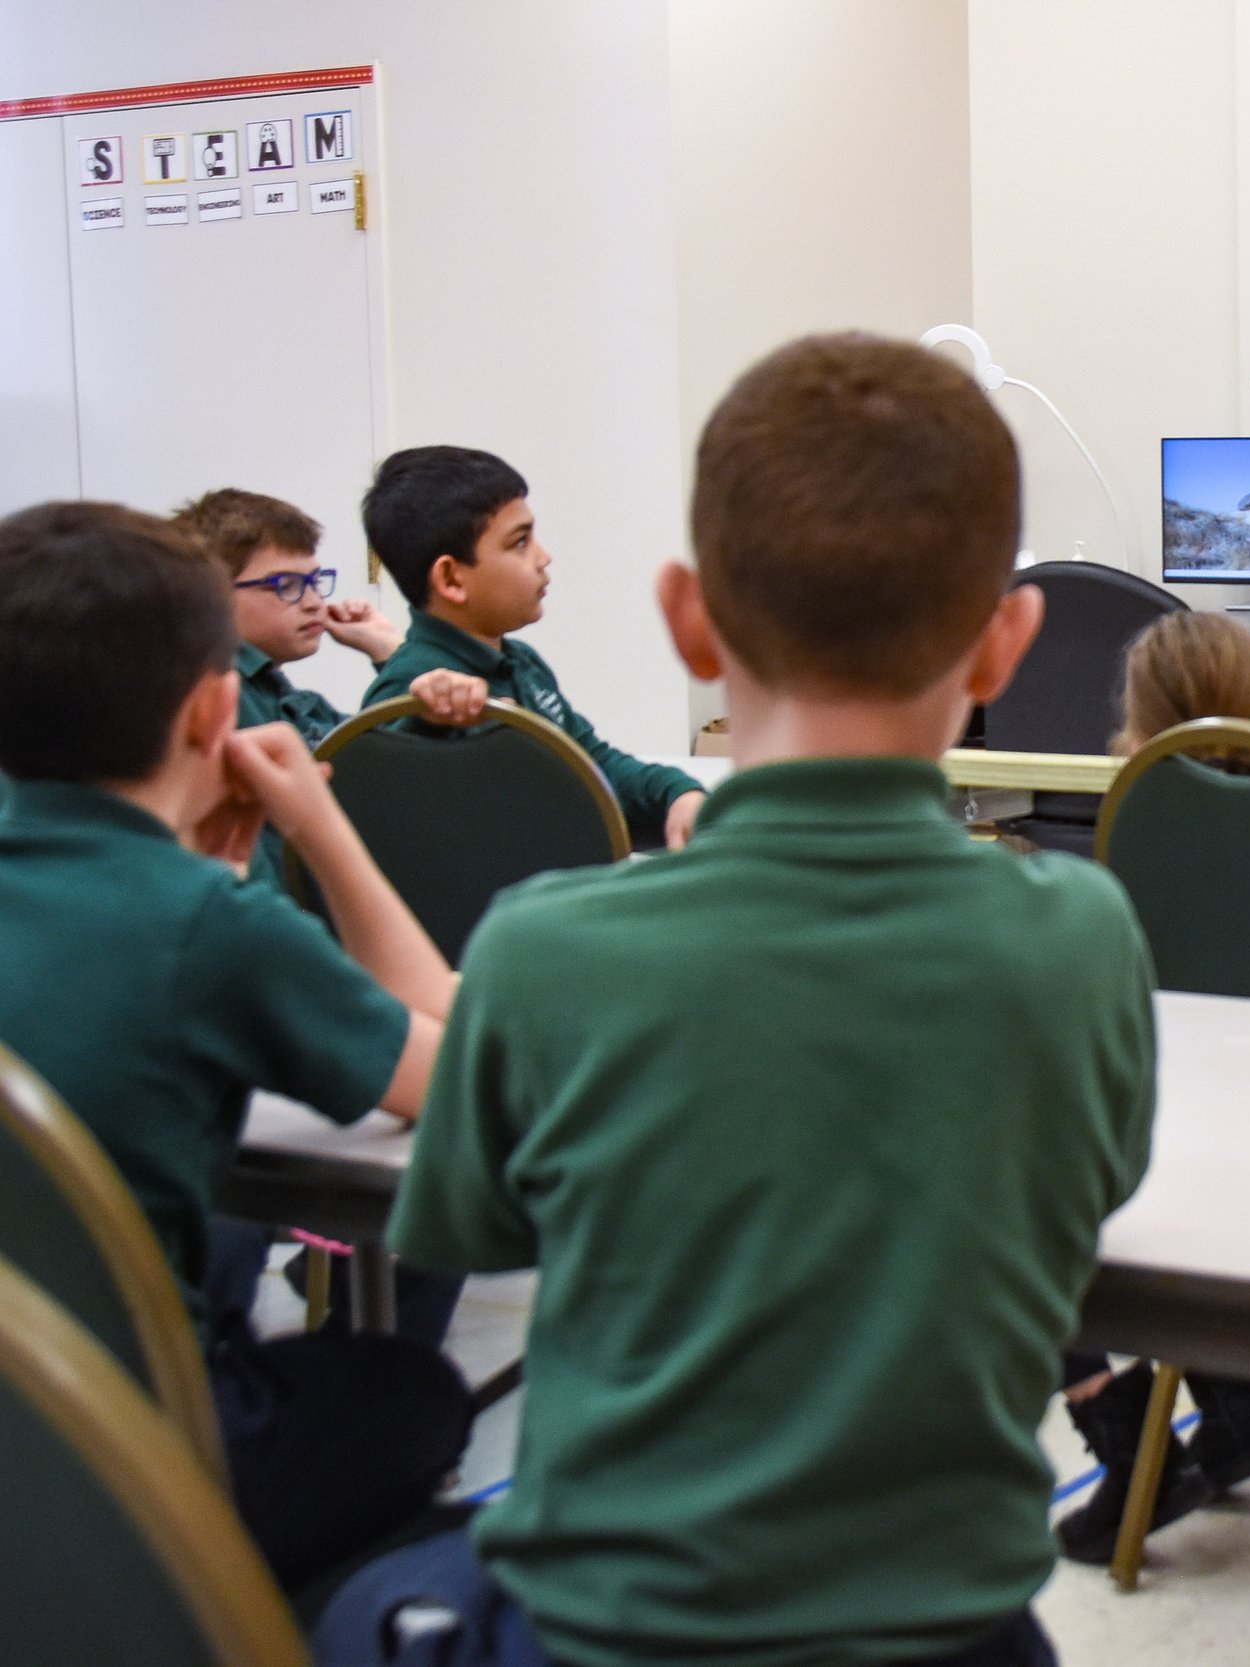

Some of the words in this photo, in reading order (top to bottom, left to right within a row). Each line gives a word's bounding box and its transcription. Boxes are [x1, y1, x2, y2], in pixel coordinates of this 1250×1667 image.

[93, 140, 114, 181] S
[258, 123, 283, 167] A
[314, 115, 345, 159] M
[83, 207, 121, 221] SCIENCE
[145, 205, 187, 216] TECHNOLOGY
[267, 192, 284, 204] ART
[320, 190, 346, 204] MATH
